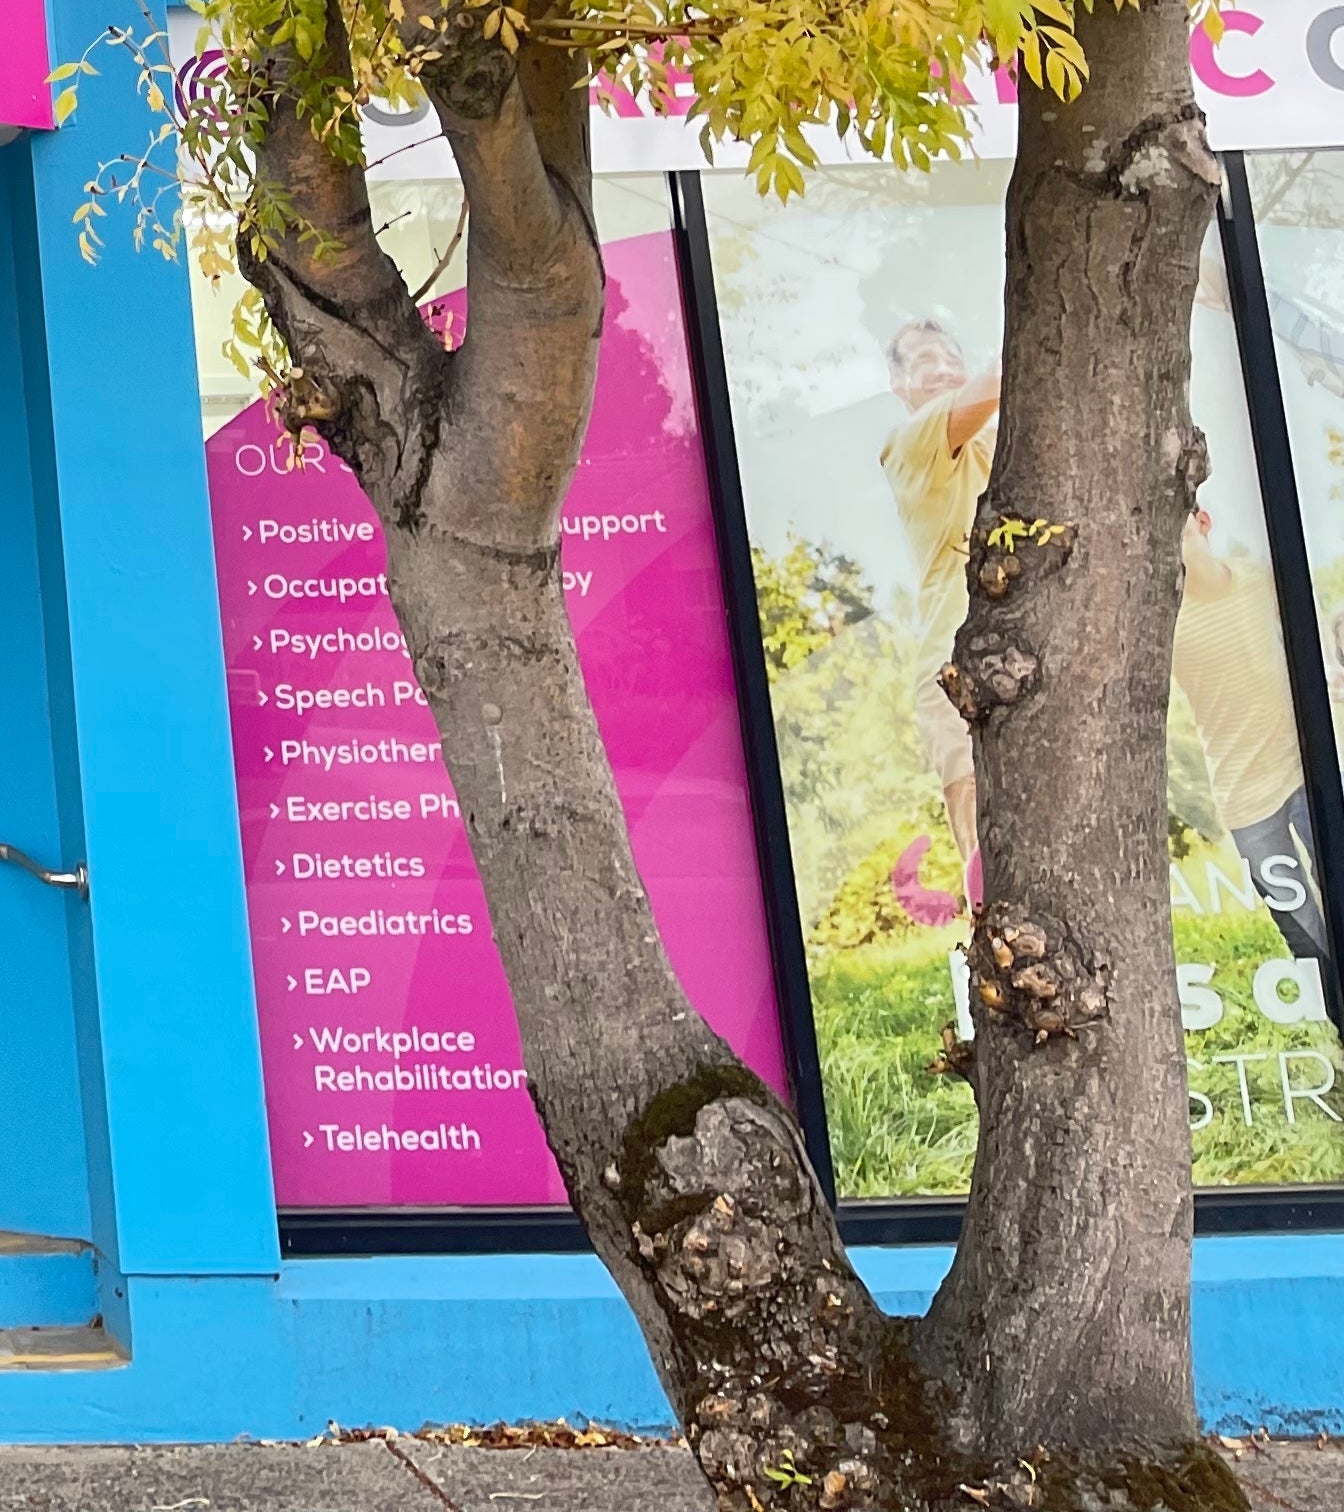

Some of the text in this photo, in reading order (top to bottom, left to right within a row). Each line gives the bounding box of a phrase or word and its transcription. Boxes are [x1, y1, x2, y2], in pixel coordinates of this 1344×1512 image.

[235, 442, 326, 476] OUR
[259, 509, 667, 545] Positive upport
[263, 573, 390, 603] Occupat
[274, 682, 386, 716] Speech
[281, 738, 443, 772] Physiother
[286, 793, 412, 822] Exercise
[293, 851, 426, 879] Dietetics
[298, 908, 474, 937] Paediatrics
[304, 967, 372, 995] EAP
[309, 1025, 476, 1060] Workplace
[319, 1122, 482, 1152] Telehealth
